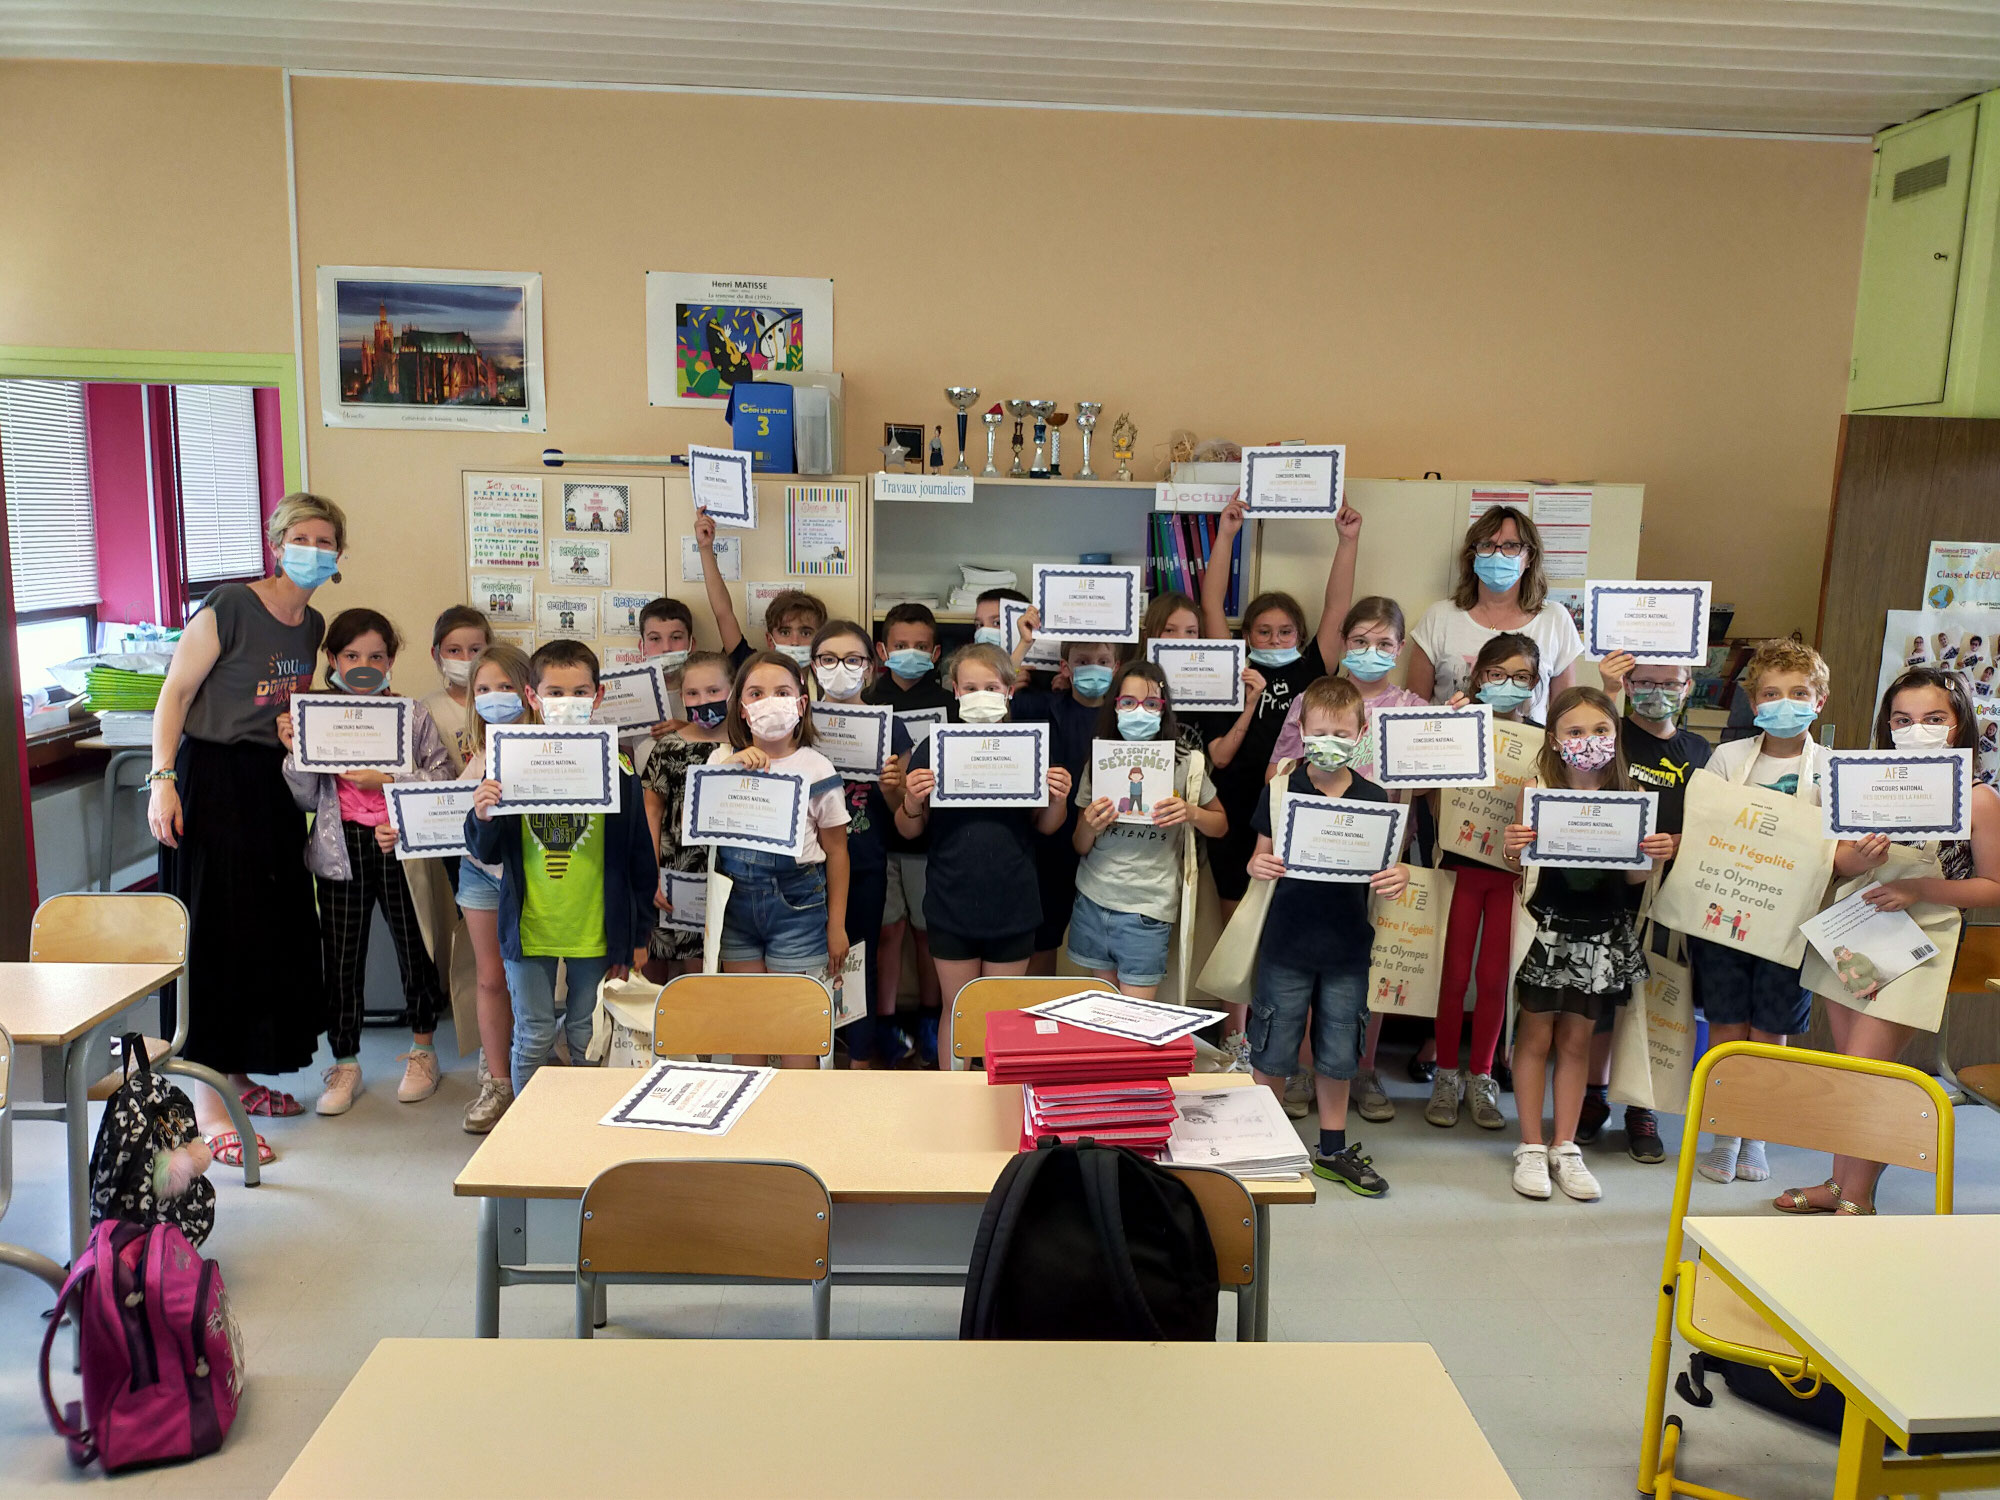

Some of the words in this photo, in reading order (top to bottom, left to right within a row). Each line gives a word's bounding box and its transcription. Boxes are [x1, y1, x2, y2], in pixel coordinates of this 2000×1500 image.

[712, 281, 732, 289] Henri
[734, 281, 768, 290] MATISSE
[757, 415, 770, 436] 3
[882, 480, 917, 494] Travaux
[918, 480, 966, 498] journaliers
[474, 549, 494, 558] joue
[527, 560, 540, 568] pas
[1936, 570, 1963, 579] Classe
[1964, 570, 1974, 579] de
[276, 658, 299, 676] YOU
[828, 716, 838, 728] AF
[1423, 721, 1433, 732] AF
[981, 738, 992, 751] AF
[1126, 747, 1150, 755] SENT
[1507, 739, 1523, 761] FDU
[1885, 766, 1898, 779] AF
[740, 778, 752, 790] AF
[727, 793, 751, 802] CONCOURS
[751, 795, 771, 804] NATIONAL
[1451, 797, 1467, 809] de
[1468, 801, 1480, 814] la
[1482, 806, 1514, 825] Parol
[1580, 805, 1592, 816] AF
[532, 813, 569, 829] LIKE
[1333, 814, 1345, 825] AF
[1733, 807, 1763, 831] AF
[1757, 812, 1780, 837] FDU
[543, 827, 577, 843] LIGHT
[1320, 829, 1344, 837] CONCOURS
[1344, 831, 1364, 839] NATIONAL
[1708, 835, 1737, 853] Dire
[1740, 843, 1796, 871] l'égalité
[1734, 861, 1755, 872] avec
[1698, 860, 1720, 876] Les
[1723, 868, 1784, 896] Olympes
[1415, 890, 1428, 911] FDU
[1694, 878, 1711, 891] de
[1714, 882, 1727, 896] la
[1730, 887, 1776, 912] Parole
[1376, 916, 1400, 930] Dire
[1401, 921, 1434, 938] l'égalité
[1390, 944, 1429, 961] Olympes
[1383, 959, 1394, 971] la
[1395, 962, 1425, 975] Parole
[1662, 983, 1680, 1007] FDU
[1647, 1040, 1682, 1057] mpes
[1649, 1055, 1675, 1070] role
